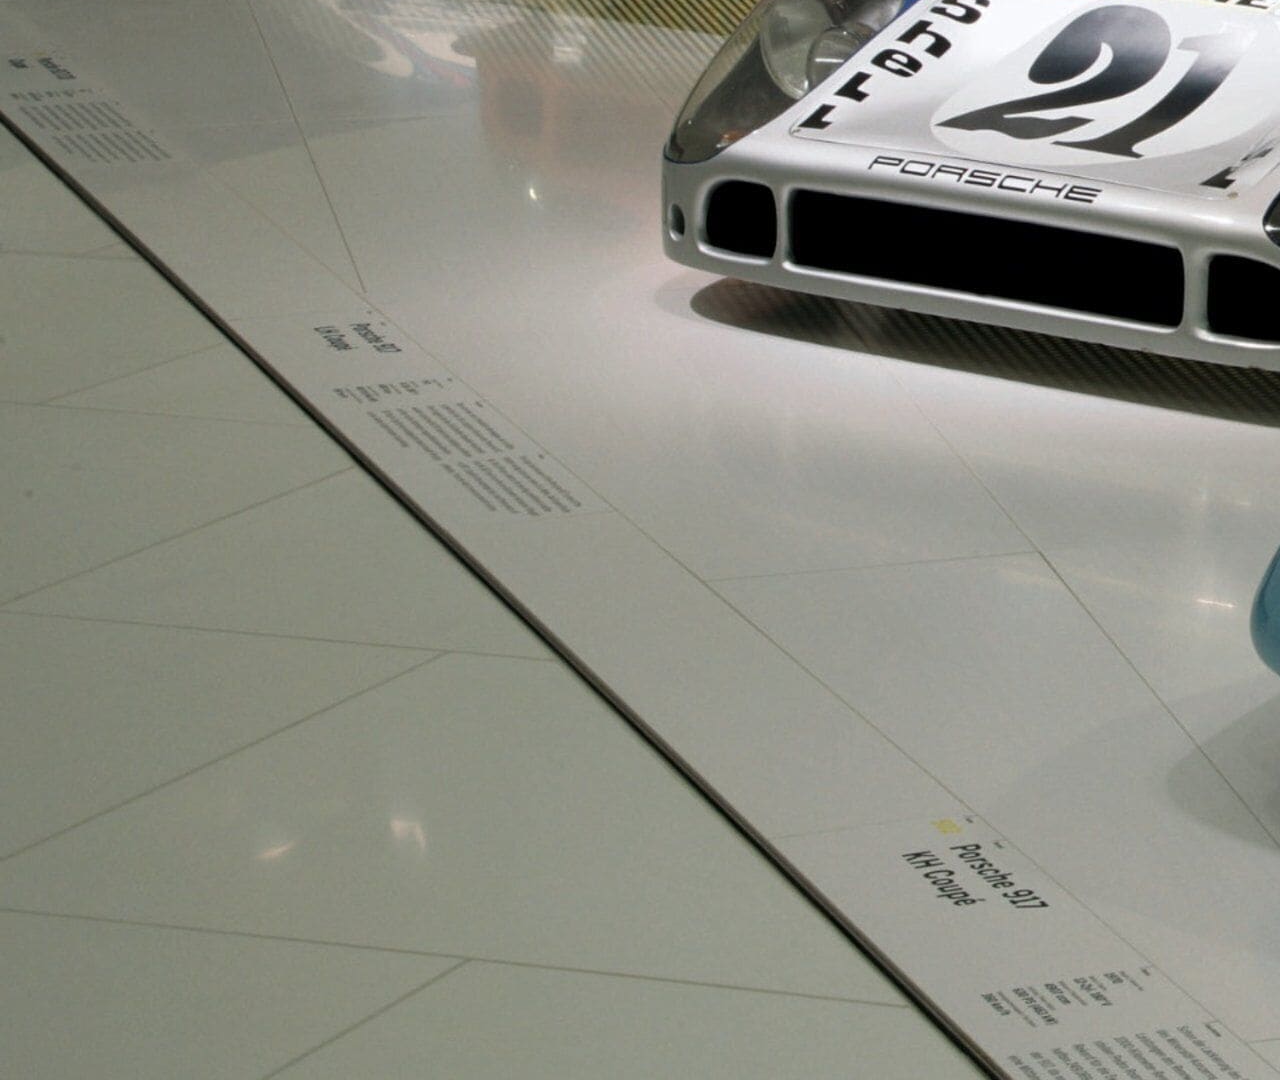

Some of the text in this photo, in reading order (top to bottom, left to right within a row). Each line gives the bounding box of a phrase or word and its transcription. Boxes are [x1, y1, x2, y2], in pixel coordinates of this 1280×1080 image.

[935, 5, 1253, 160] 21
[868, 154, 1103, 204] PORSCHE
[902, 850, 986, 907] KH Coupé
[950, 843, 1049, 909] Porsche 917
